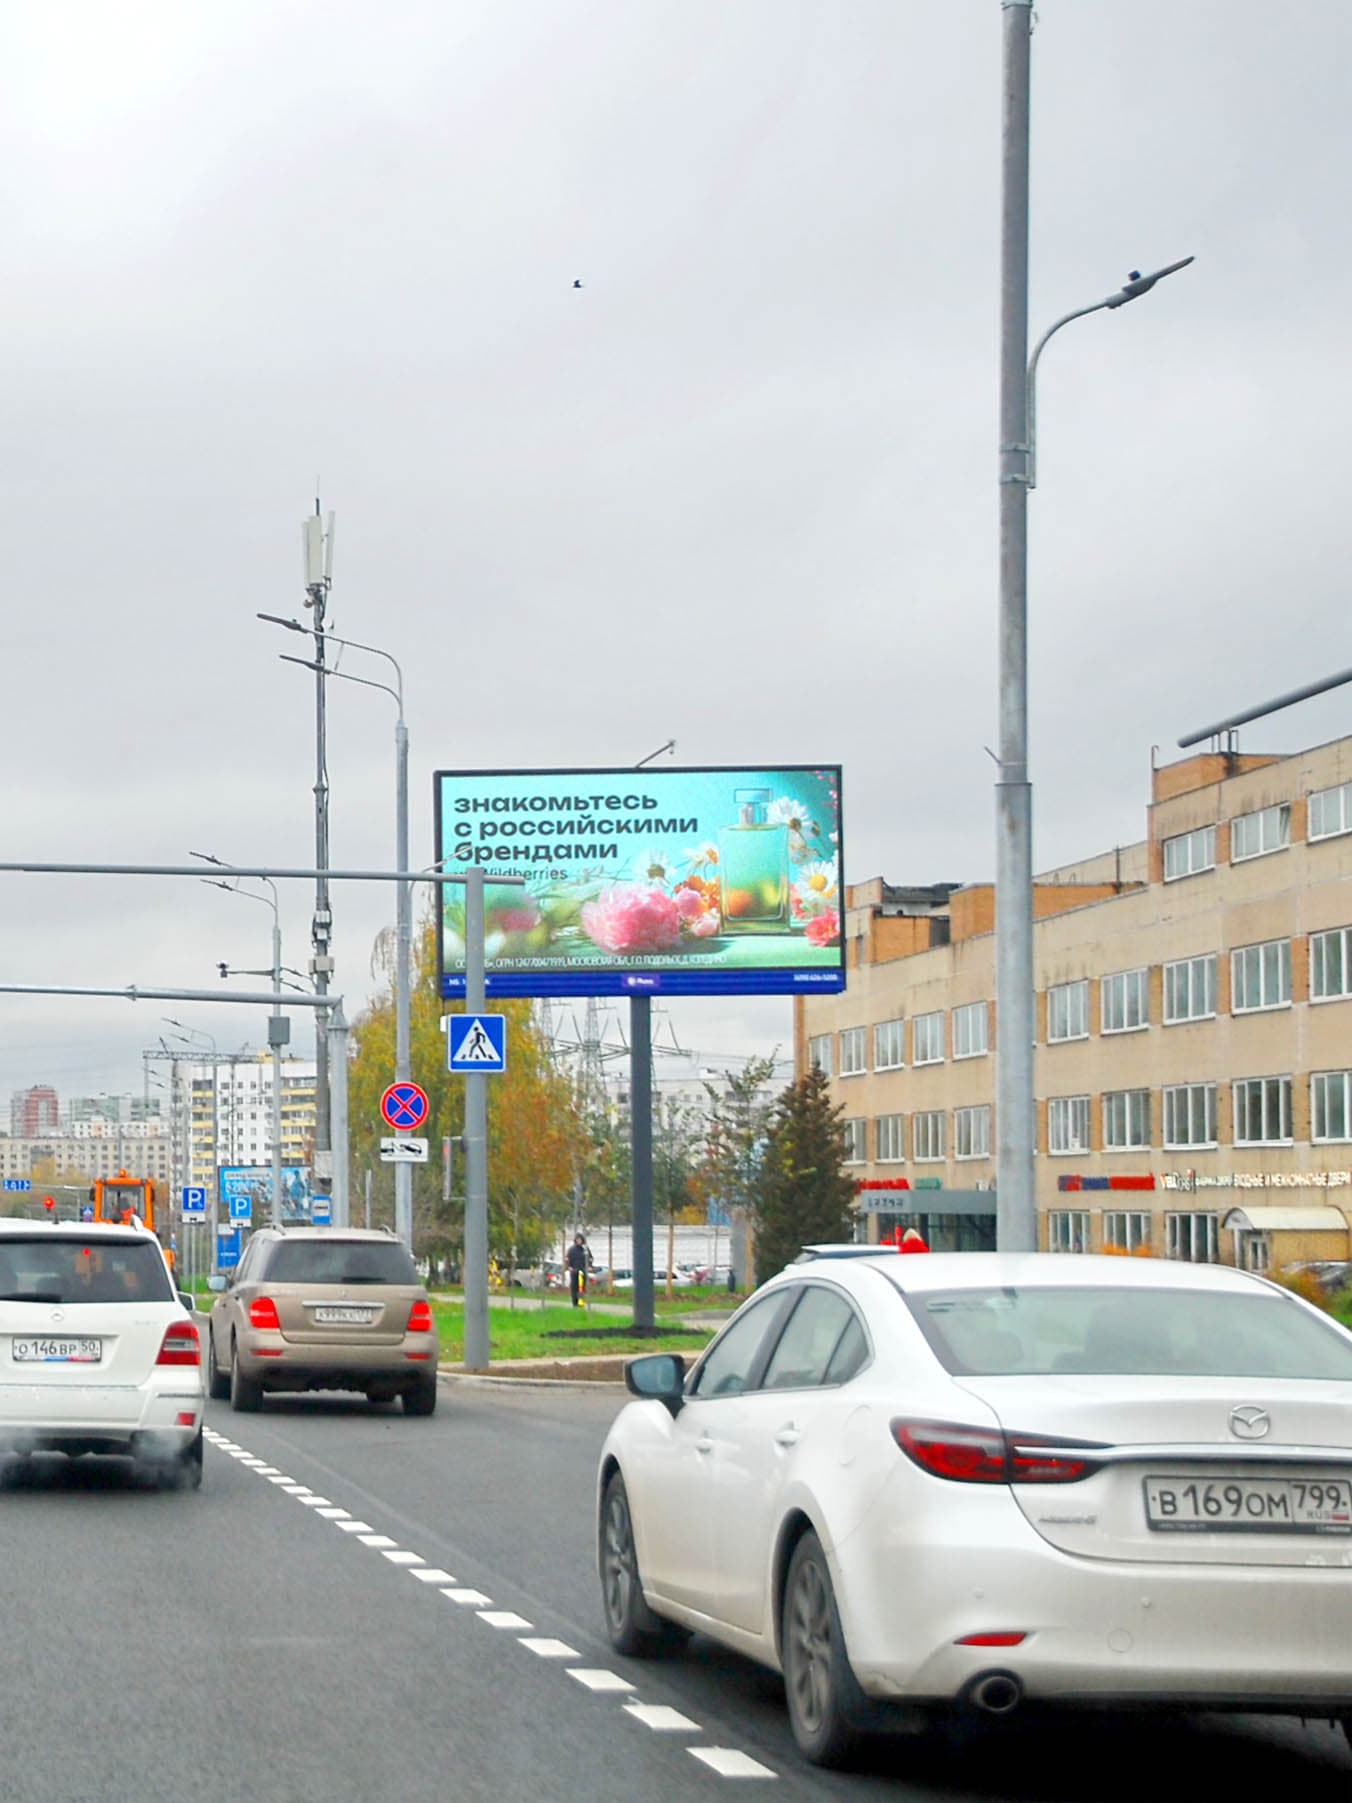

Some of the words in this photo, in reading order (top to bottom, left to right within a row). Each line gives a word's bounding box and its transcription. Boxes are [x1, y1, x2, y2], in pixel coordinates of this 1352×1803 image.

[454, 794, 658, 813] знакомьтесь
[454, 821, 472, 837] с
[479, 814, 698, 840] российскими
[454, 841, 618, 864] брендами
[188, 1189, 202, 1209] P
[235, 1198, 248, 1216] P
[1292, 1484, 1342, 1510] 799
